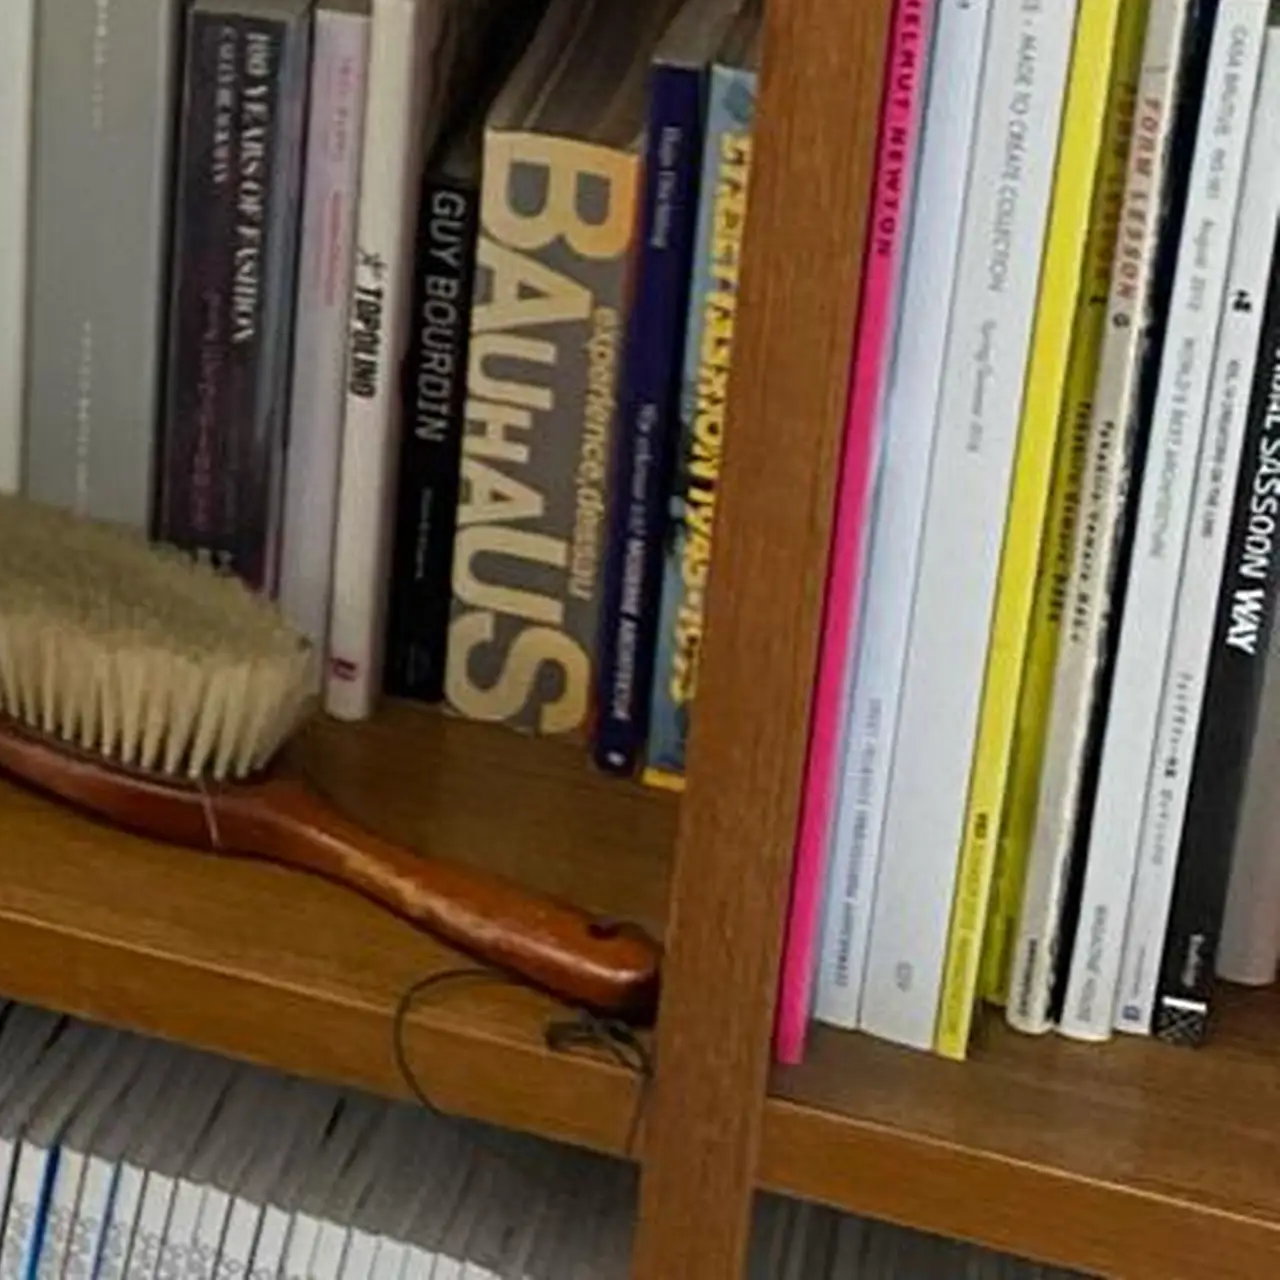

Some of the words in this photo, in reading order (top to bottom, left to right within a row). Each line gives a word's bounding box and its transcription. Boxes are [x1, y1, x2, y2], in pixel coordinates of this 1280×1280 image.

[1008, 90, 1032, 115] TO
[1012, 32, 1040, 87] MADE
[237, 84, 269, 177] YEARS
[1133, 96, 1162, 178] FORM
[235, 179, 264, 220] OF
[424, 189, 468, 268] GUY
[872, 125, 909, 257] NEWTON
[985, 183, 1021, 293] COLLECTION
[1117, 189, 1150, 300] LESSON
[228, 224, 261, 344] FASHION
[346, 285, 386, 399] TOPOLINO
[408, 274, 464, 442] BOURDIN
[444, 130, 638, 735] BAUHAUS
[1240, 437, 1280, 580] SASSOON
[1225, 587, 1266, 655] WAY
